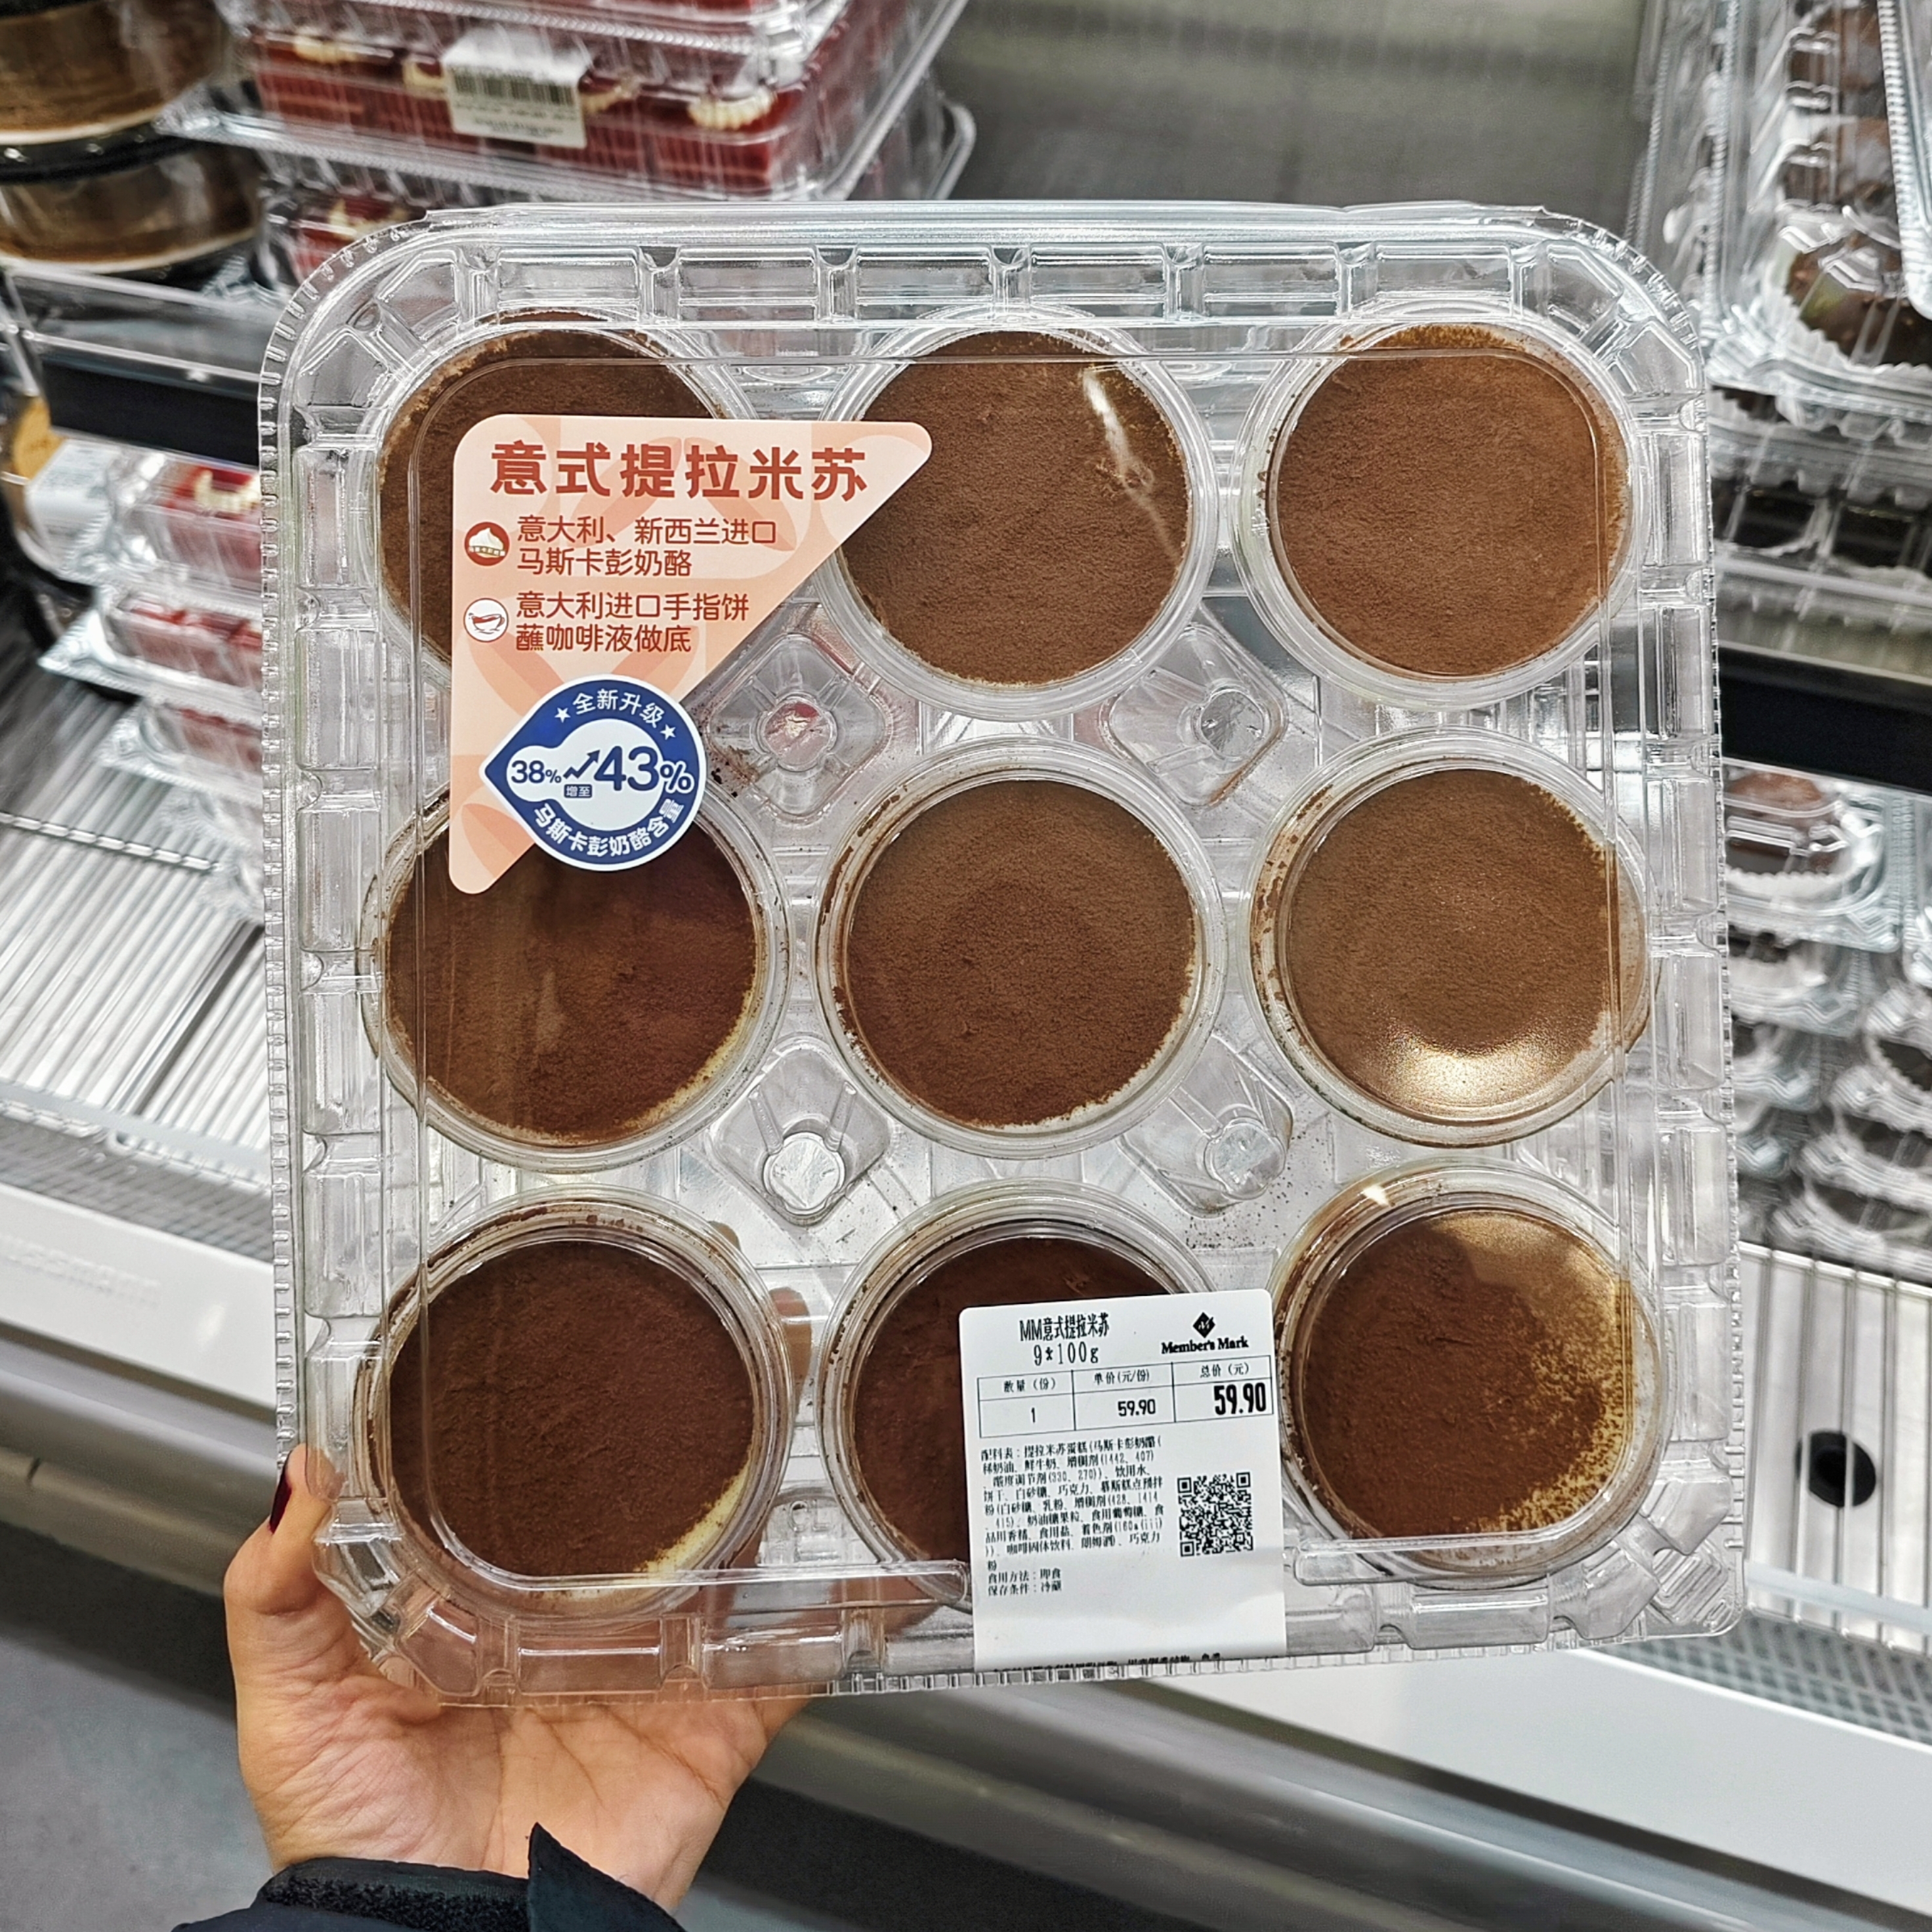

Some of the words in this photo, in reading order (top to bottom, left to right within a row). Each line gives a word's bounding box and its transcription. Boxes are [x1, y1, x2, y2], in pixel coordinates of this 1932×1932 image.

[490, 440, 868, 501] 意式提拉米苏
[516, 515, 776, 545] 意大利、新西兰进口
[516, 547, 692, 577] 马斯卡彭奶酪
[516, 591, 750, 621] 意大利进口手指饼
[516, 623, 692, 653] 蘸咖啡液做底
[573, 688, 665, 728] 全新升级
[511, 760, 562, 784] 38%
[593, 746, 694, 792] 43%
[566, 786, 591, 797] 增至
[534, 799, 684, 857] 马斯卡彭奶酪含量
[1020, 1312, 1110, 1341] MM意式提拉米苏
[1161, 1338, 1215, 1354] Member's
[1218, 1335, 1249, 1350] Mark
[1118, 1399, 1156, 1417] 59.90
[1214, 1383, 1267, 1415] 59.90
[1031, 1408, 1036, 1423] 1
